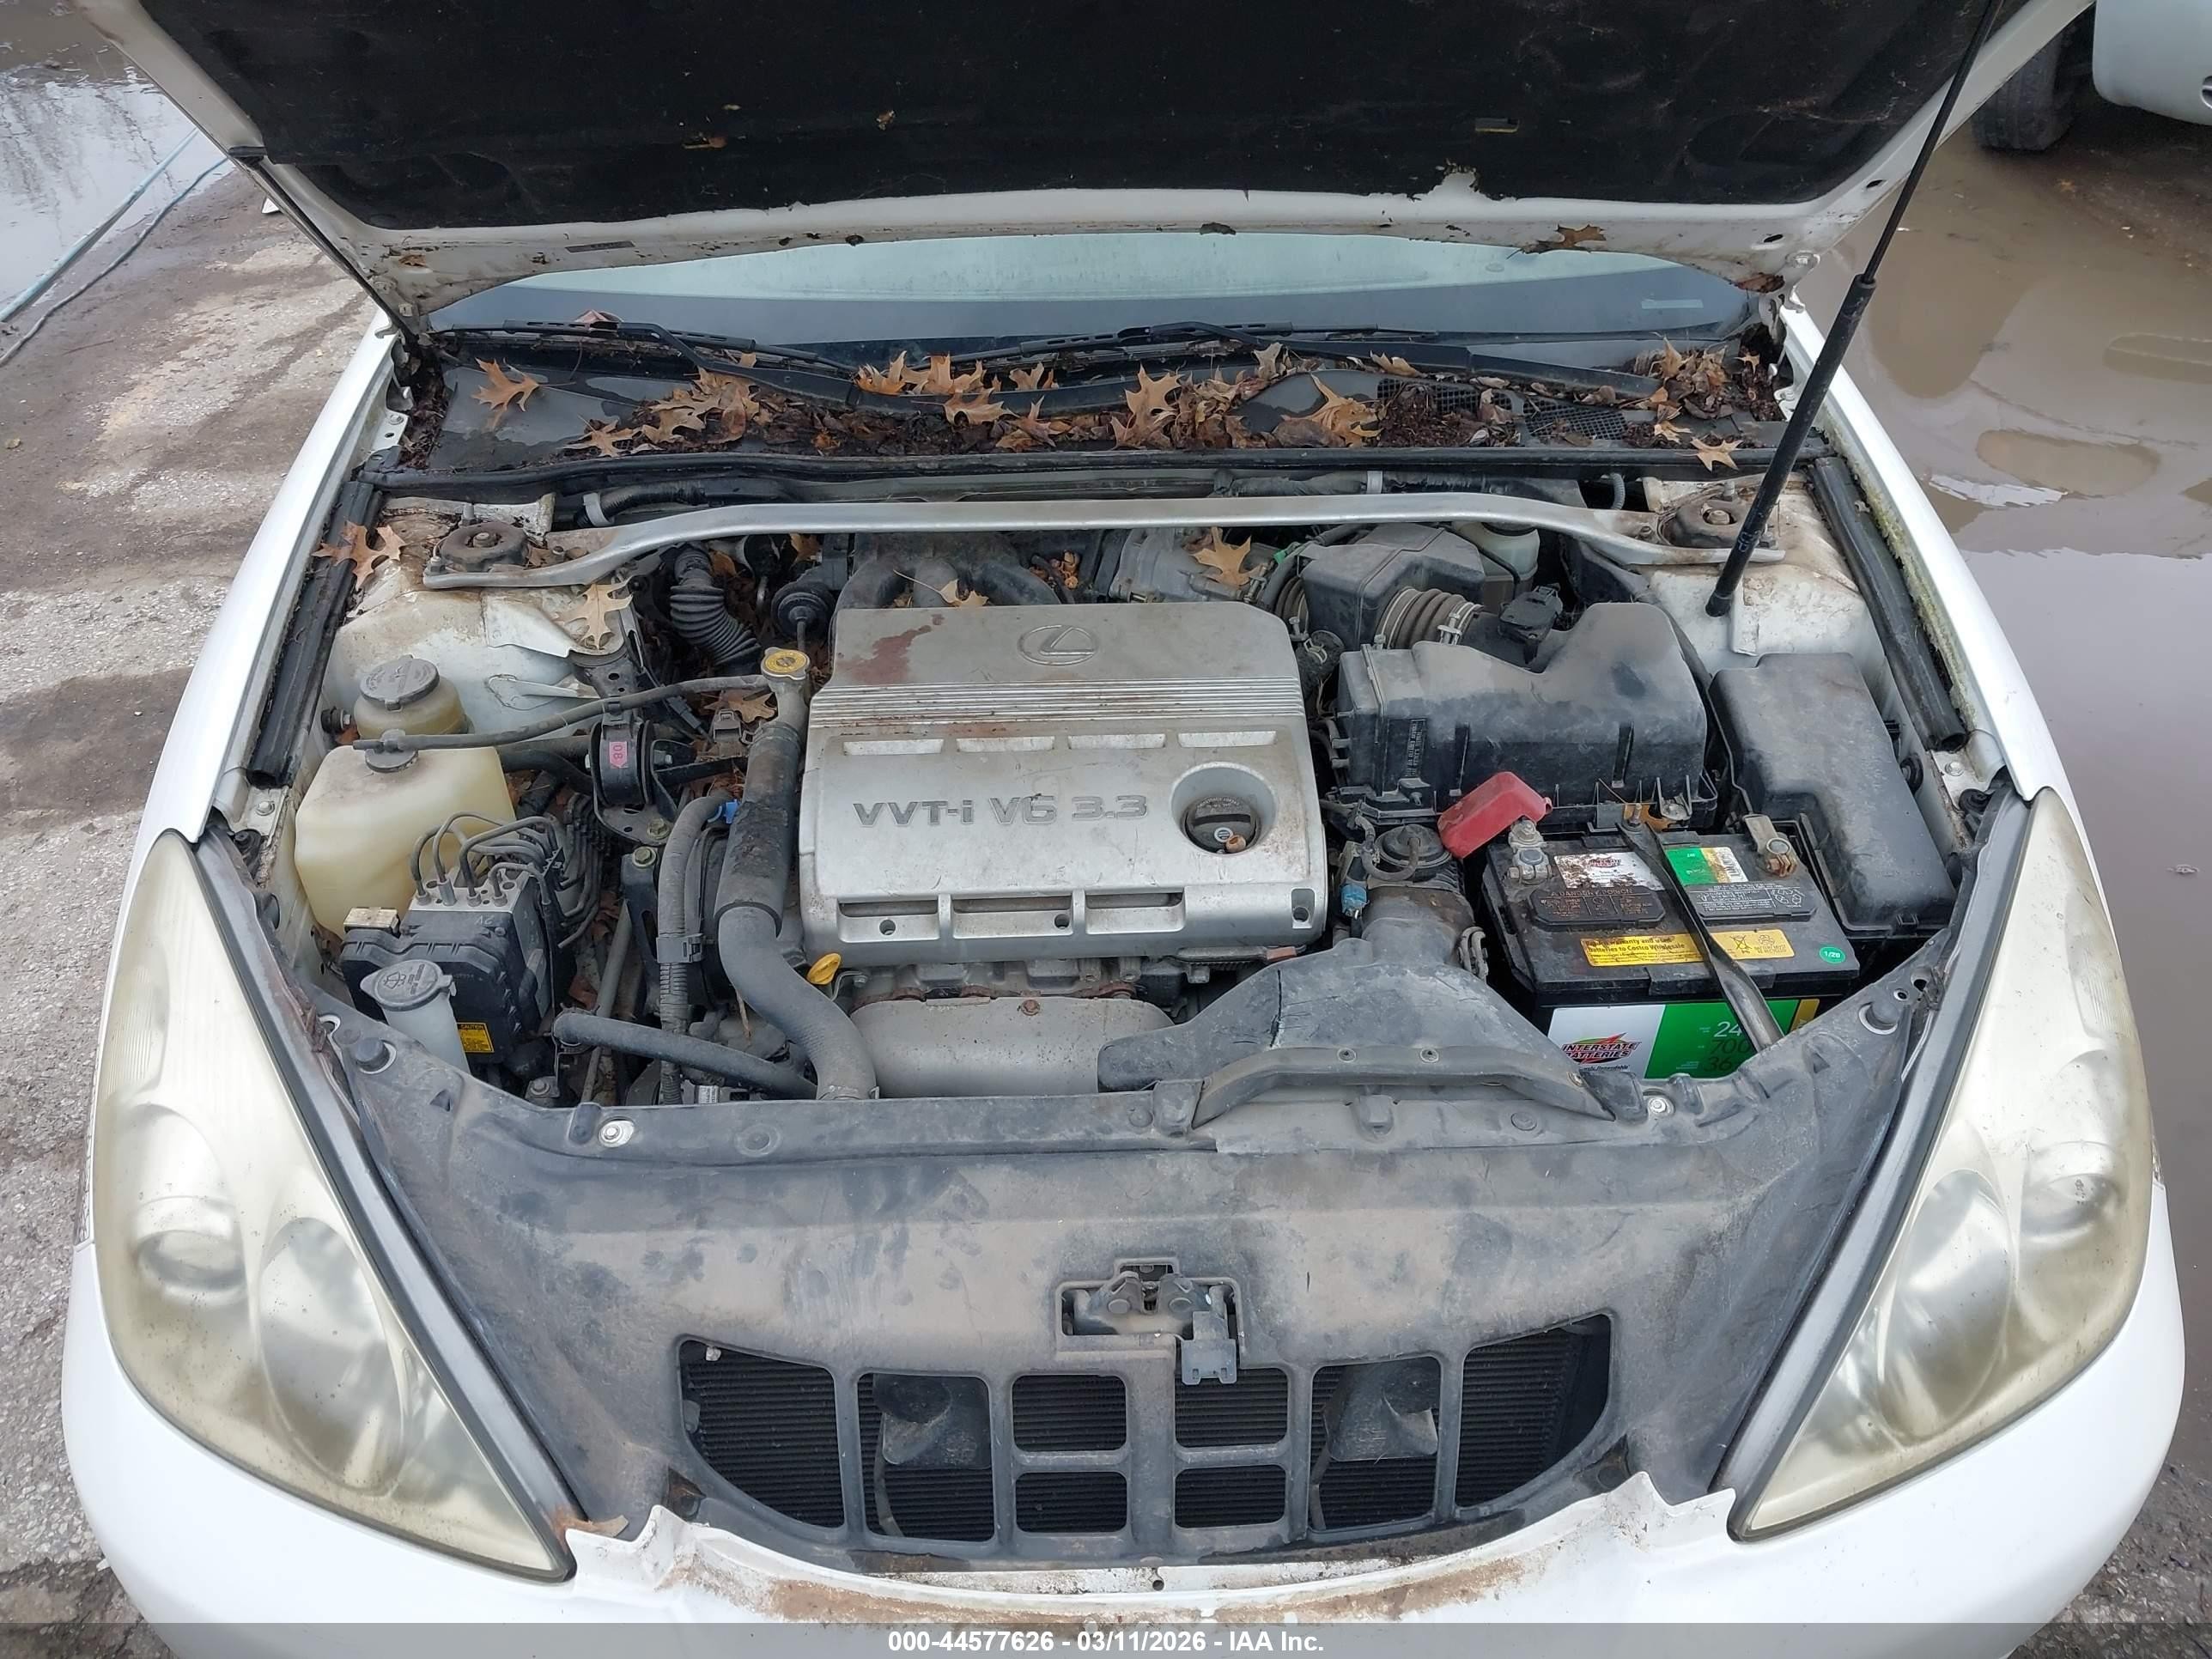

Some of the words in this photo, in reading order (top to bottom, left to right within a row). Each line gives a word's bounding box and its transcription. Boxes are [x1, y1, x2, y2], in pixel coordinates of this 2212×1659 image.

[853, 799, 973, 827] VVT-i
[989, 793, 1056, 825] V6
[1072, 794, 1147, 820] 3.3
[1562, 1042, 1637, 1052] INTERSTATE
